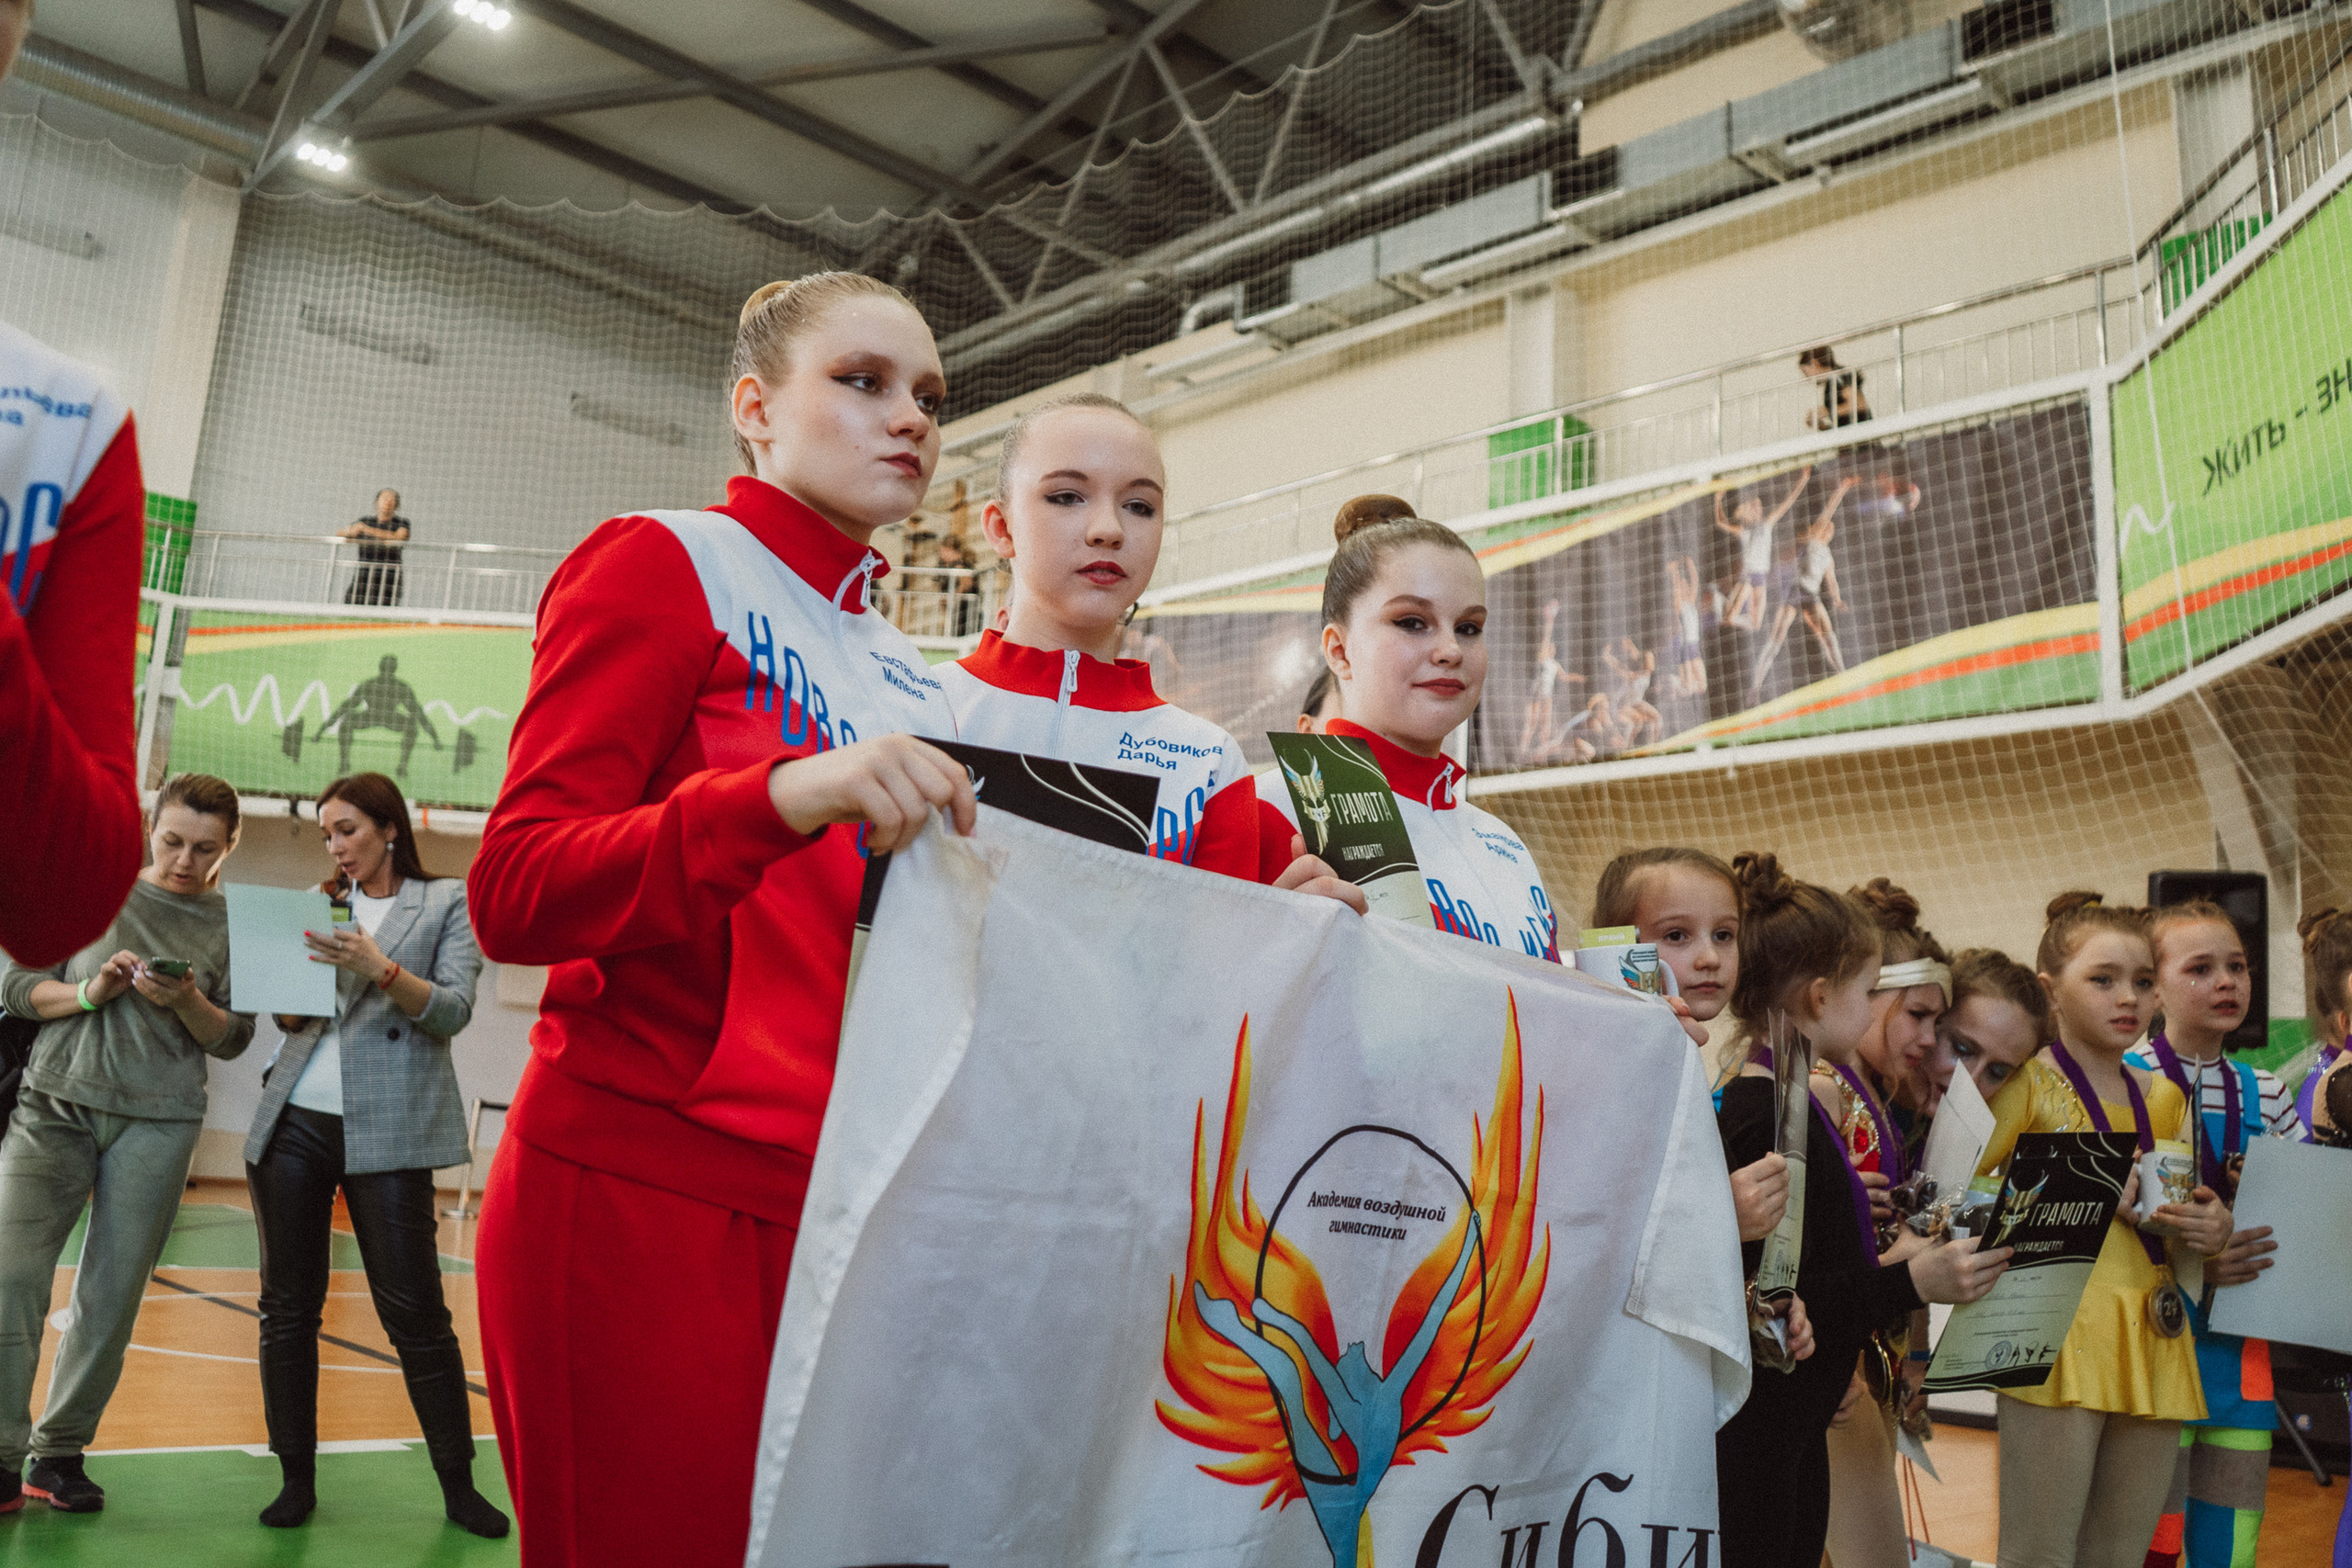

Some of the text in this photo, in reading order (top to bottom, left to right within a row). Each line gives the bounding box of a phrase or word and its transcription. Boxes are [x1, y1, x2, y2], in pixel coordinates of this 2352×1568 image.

[2202, 418, 2286, 496] ЖИТЬ
[882, 666, 926, 701] Милена
[1117, 749, 1177, 770] Дарья
[1329, 792, 1394, 825] ГРАМОТА
[1307, 1190, 1446, 1222] Академия воздушной
[2029, 1201, 2104, 1227] ГРАМОТА
[1329, 1220, 1407, 1240] гимнастики
[1415, 1472, 1722, 1568] Сиби
